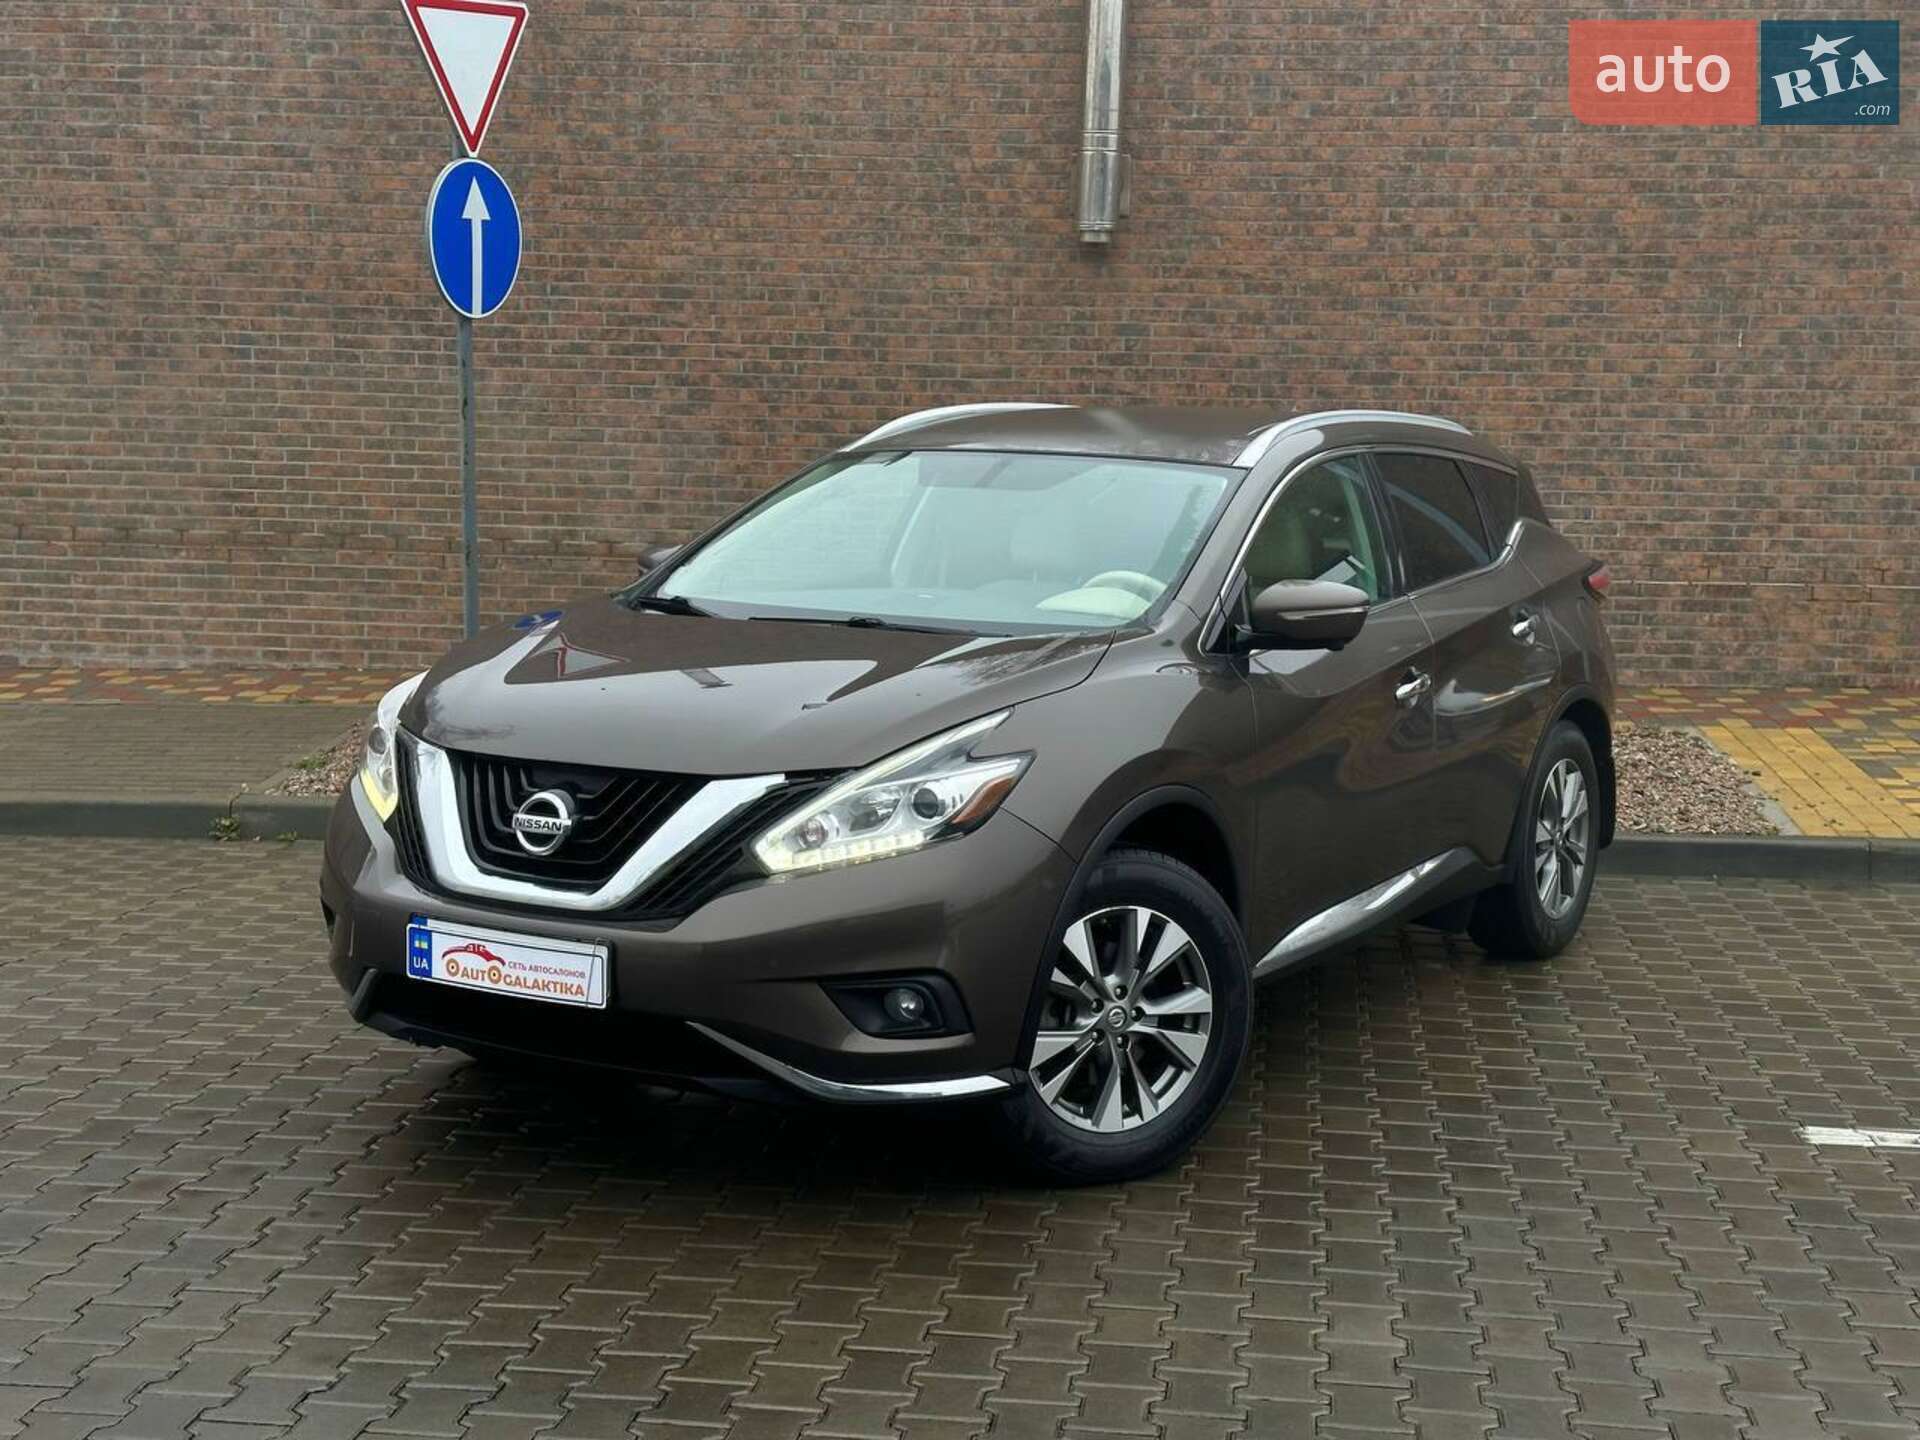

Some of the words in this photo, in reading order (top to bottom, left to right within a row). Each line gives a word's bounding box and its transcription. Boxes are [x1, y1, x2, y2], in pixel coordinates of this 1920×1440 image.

[514, 817, 562, 831] NISSAN
[413, 957, 429, 970] UA
[508, 961, 526, 972] СЕТЬ
[528, 965, 586, 979] АВТОСАЛОНОВ
